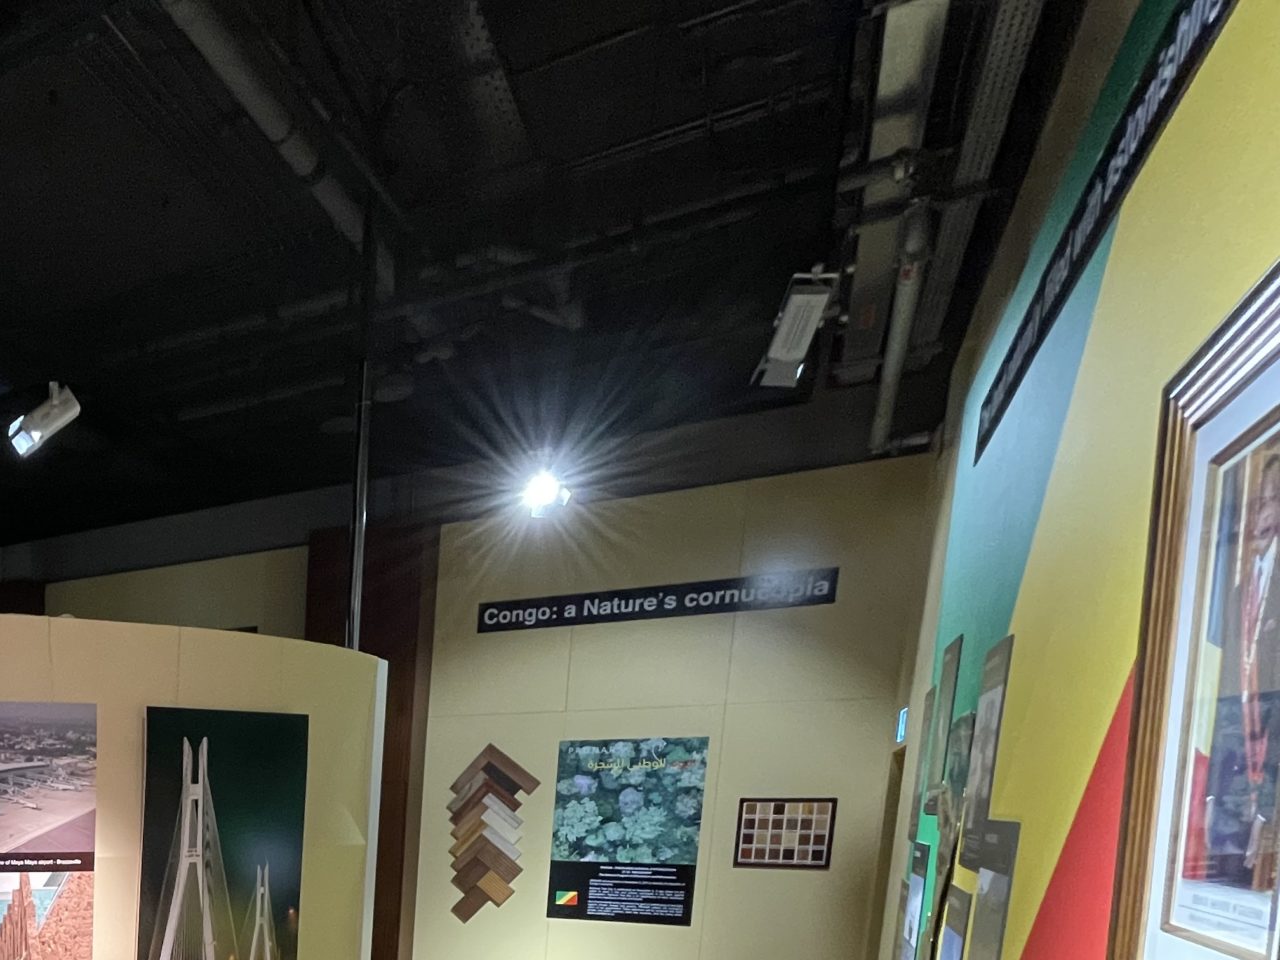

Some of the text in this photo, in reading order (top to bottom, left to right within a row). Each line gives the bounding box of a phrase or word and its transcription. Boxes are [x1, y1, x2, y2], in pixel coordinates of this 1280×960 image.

[483, 602, 558, 626] Congo:
[563, 605, 577, 618] a
[583, 591, 677, 617] Nature's
